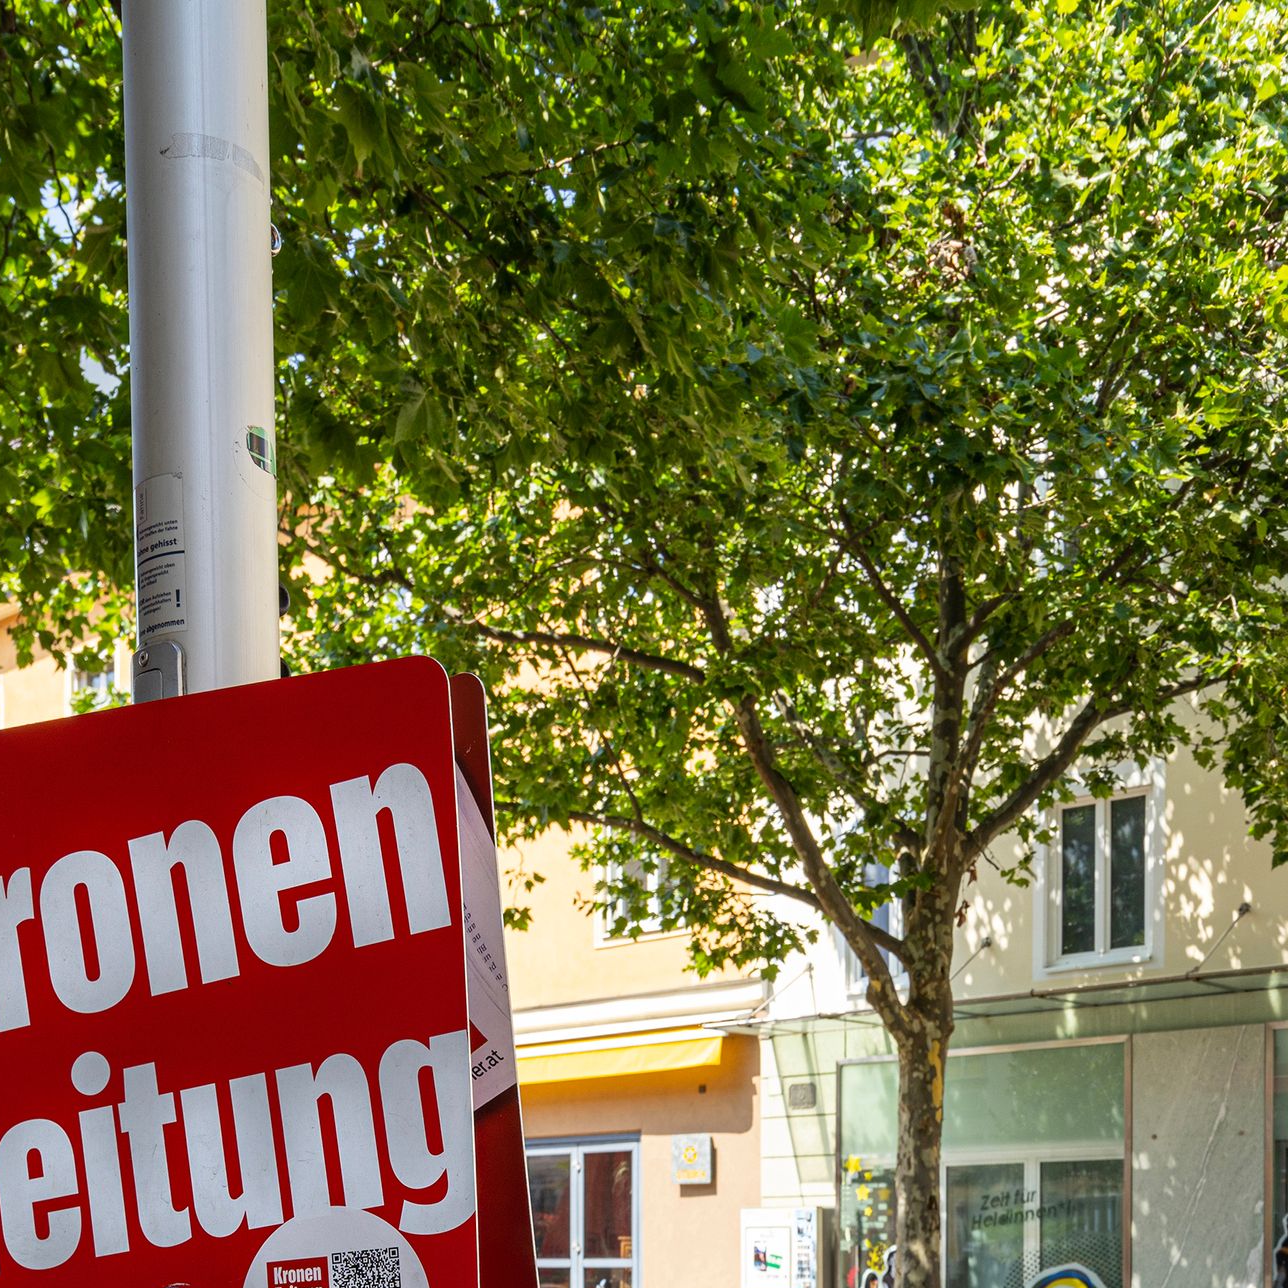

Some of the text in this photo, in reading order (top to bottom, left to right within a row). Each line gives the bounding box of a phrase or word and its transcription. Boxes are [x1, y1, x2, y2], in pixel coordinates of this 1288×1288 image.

[150, 538, 177, 553] gehisst
[146, 619, 185, 633] abgenommen
[980, 1191, 1011, 1211] Zeit
[273, 1265, 322, 1285] Kronen
